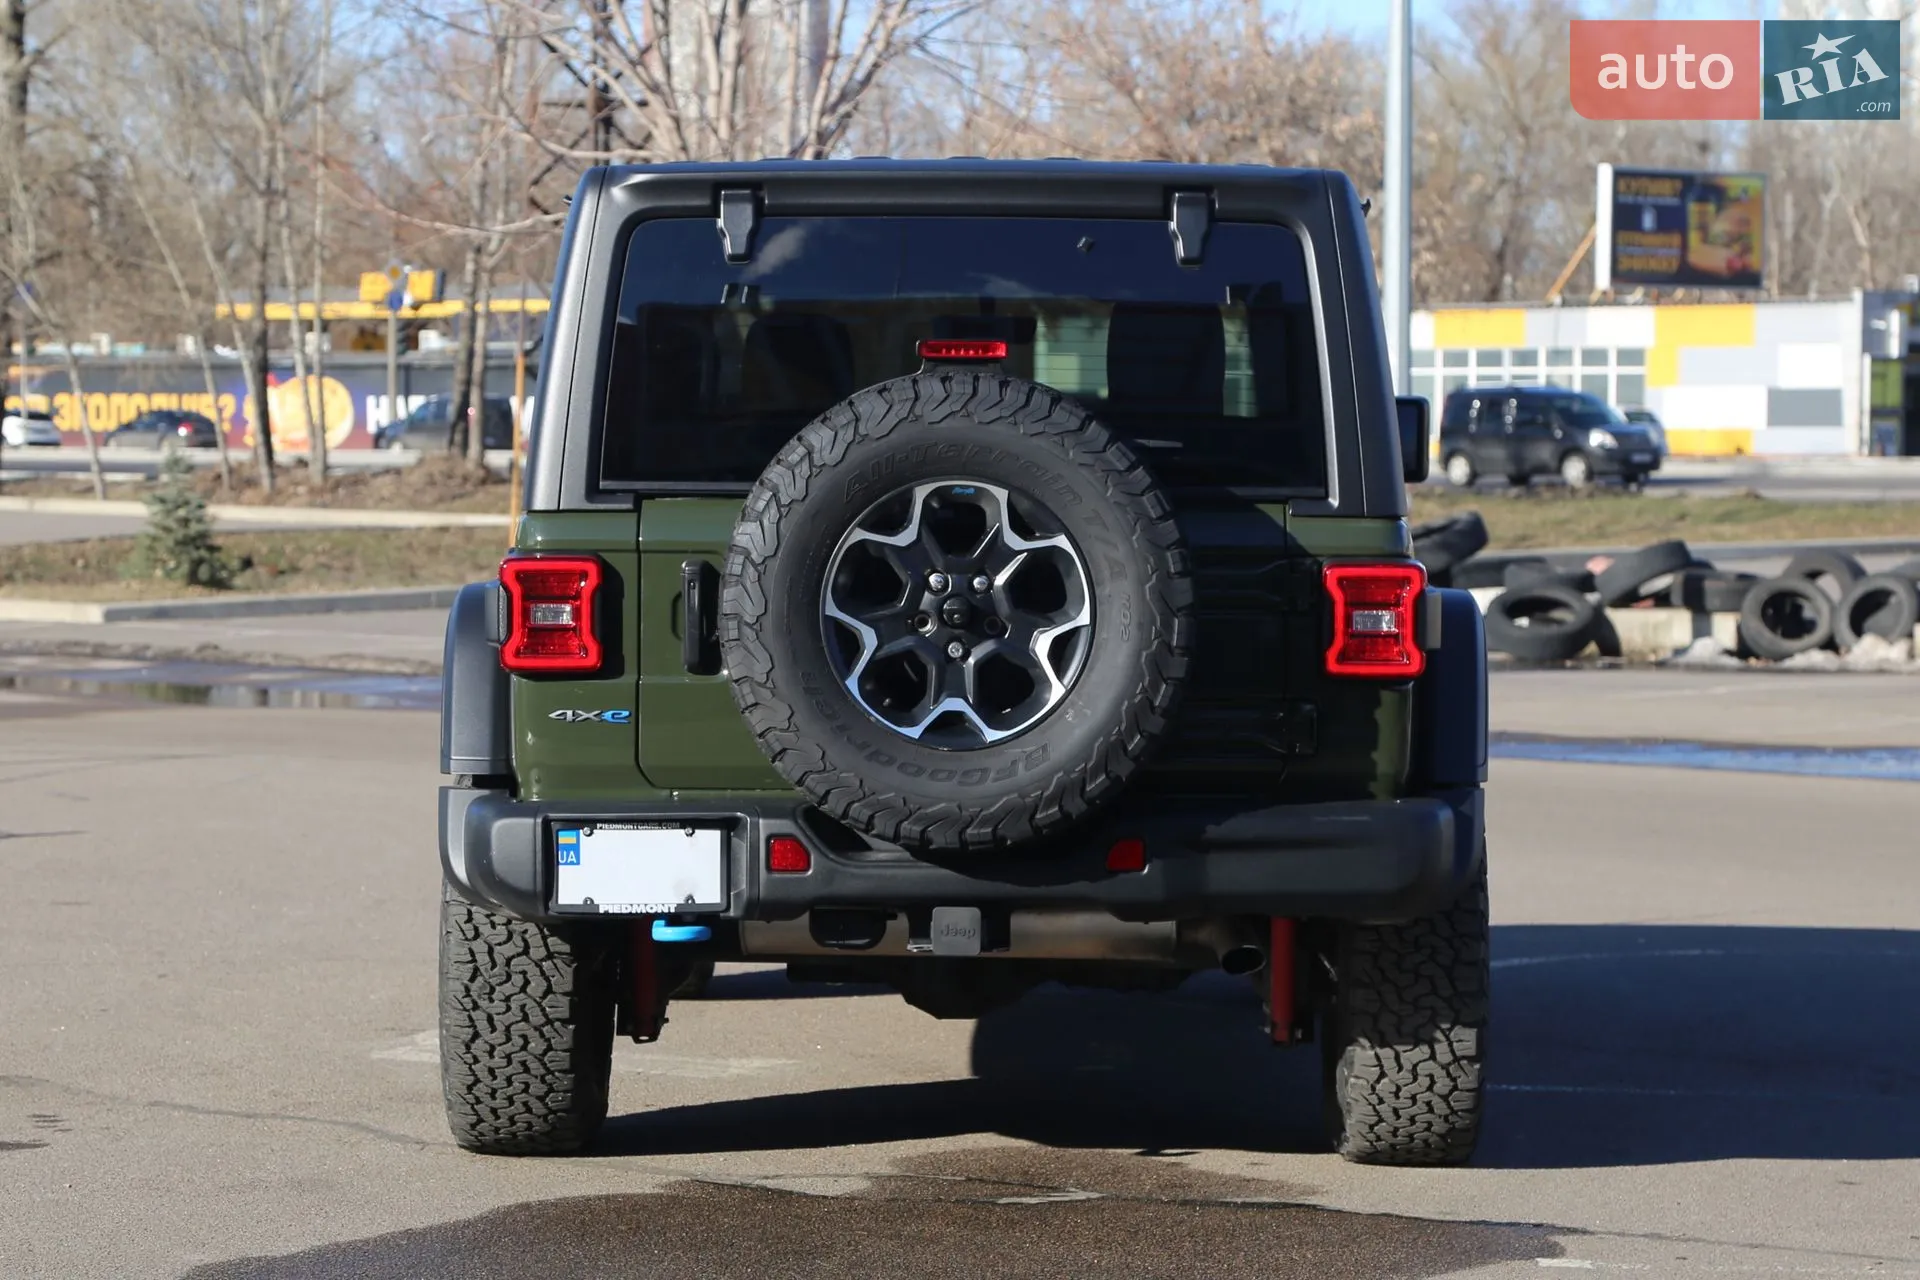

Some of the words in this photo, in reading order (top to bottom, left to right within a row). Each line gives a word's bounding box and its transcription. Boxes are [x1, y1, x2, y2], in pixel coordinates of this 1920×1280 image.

[843, 441, 1084, 507] All-Terrain
[799, 670, 1052, 787] BFGoodrich
[558, 851, 577, 863] UA
[598, 903, 677, 914] PIEDMONT
[940, 923, 976, 940] Jeep
